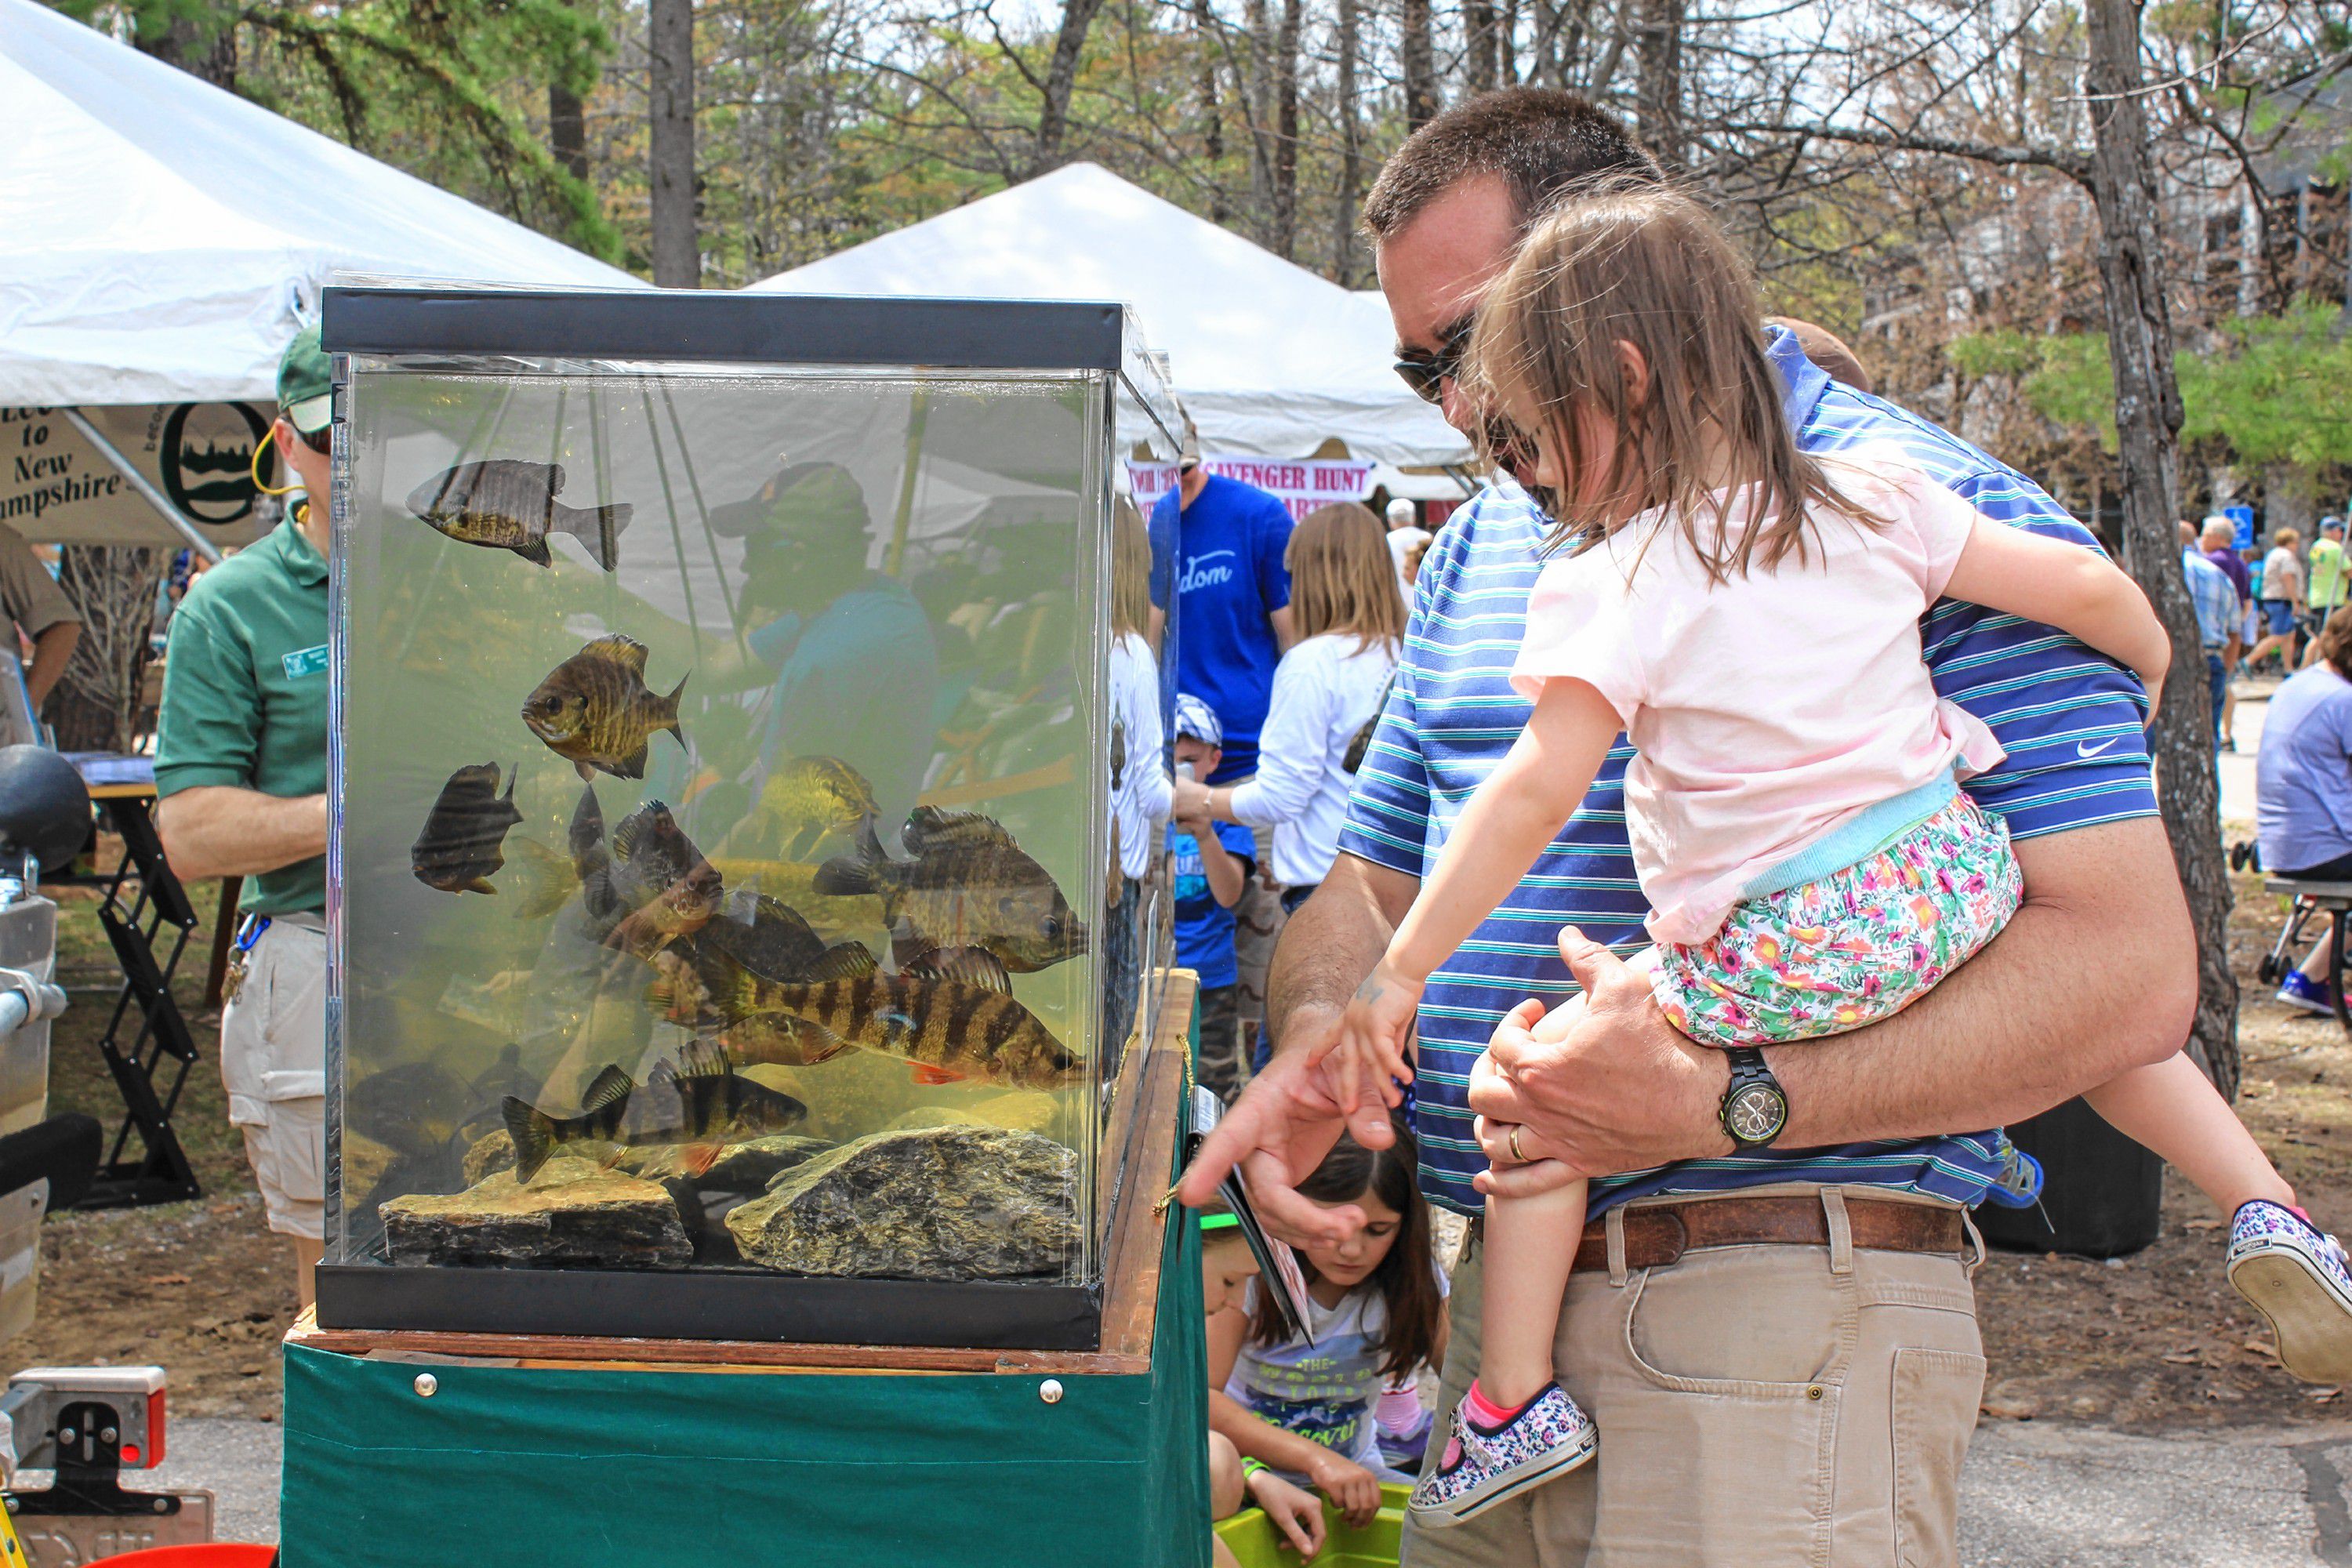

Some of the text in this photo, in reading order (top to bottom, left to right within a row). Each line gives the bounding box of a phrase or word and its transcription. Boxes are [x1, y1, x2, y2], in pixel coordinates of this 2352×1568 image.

[22, 424, 49, 447] to
[15, 453, 72, 484] New
[1314, 467, 1367, 492] HUNT
